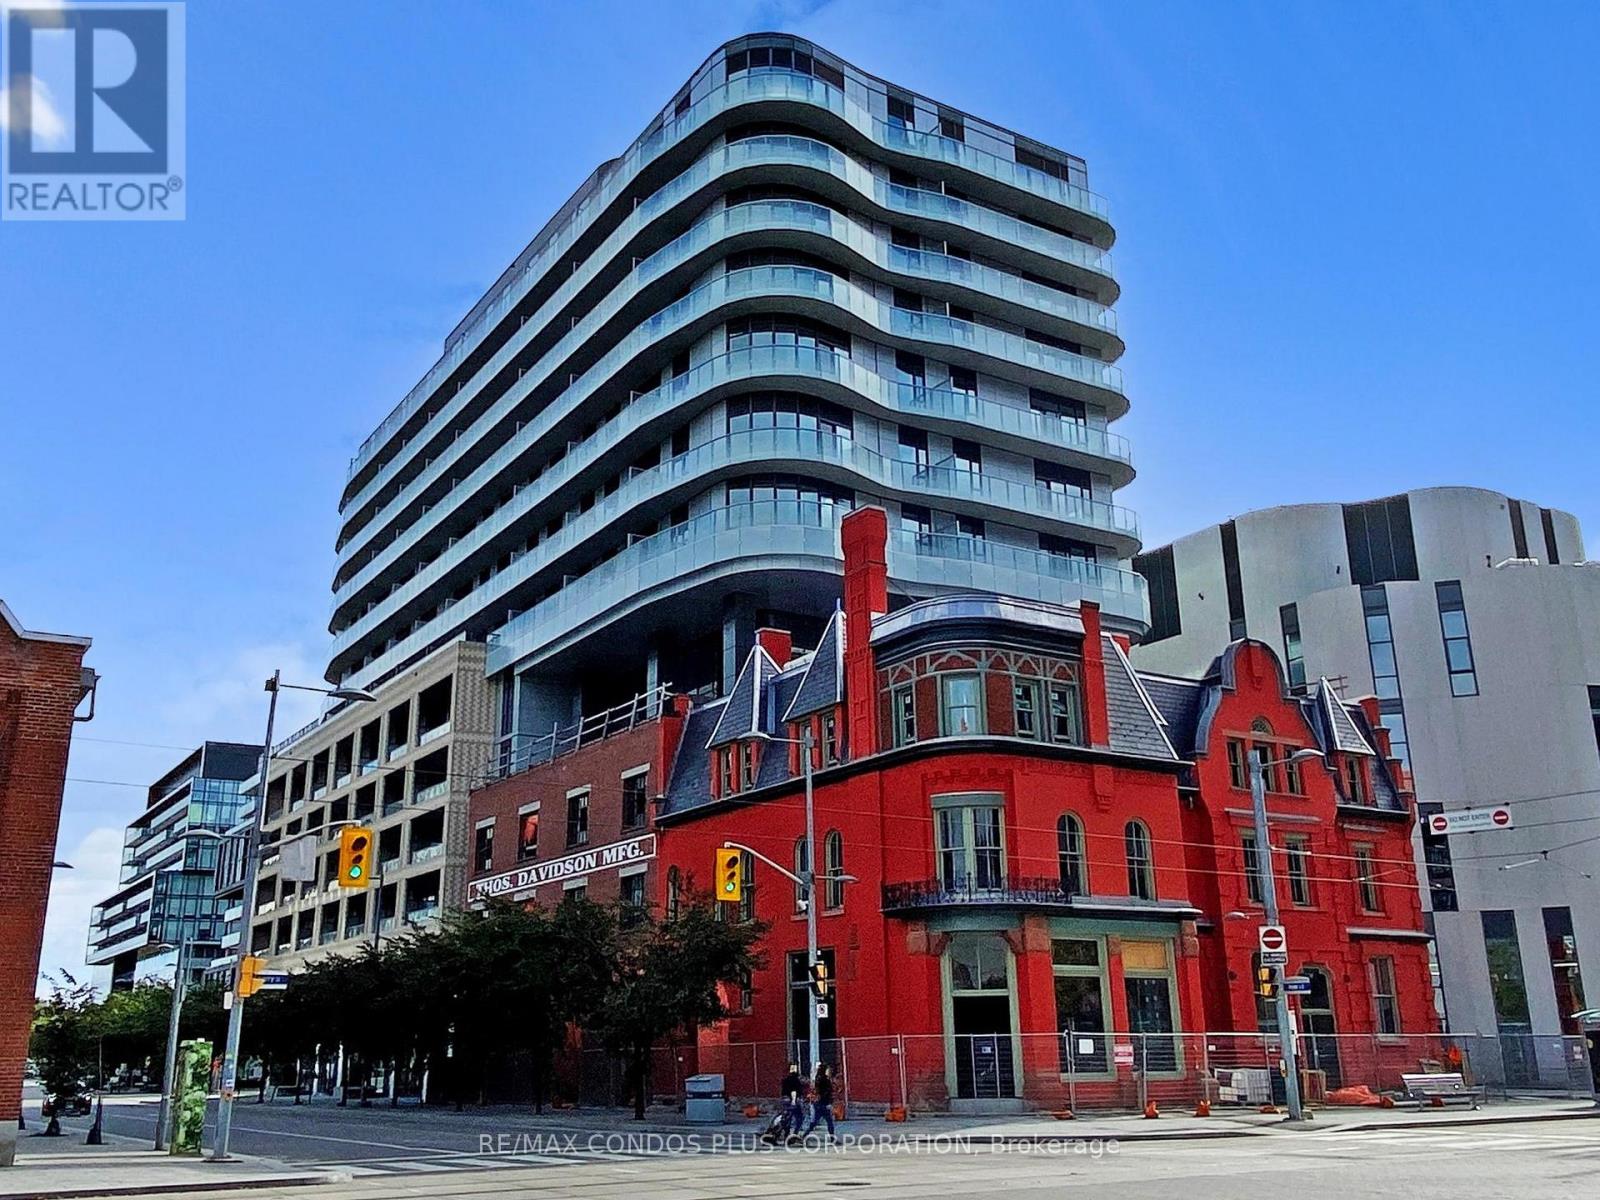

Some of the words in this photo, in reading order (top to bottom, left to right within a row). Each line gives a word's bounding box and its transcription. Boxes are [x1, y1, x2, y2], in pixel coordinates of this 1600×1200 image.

[475, 876, 514, 896] THOS.
[517, 852, 597, 886] DAVIDSON
[602, 841, 645, 865] MFG.
